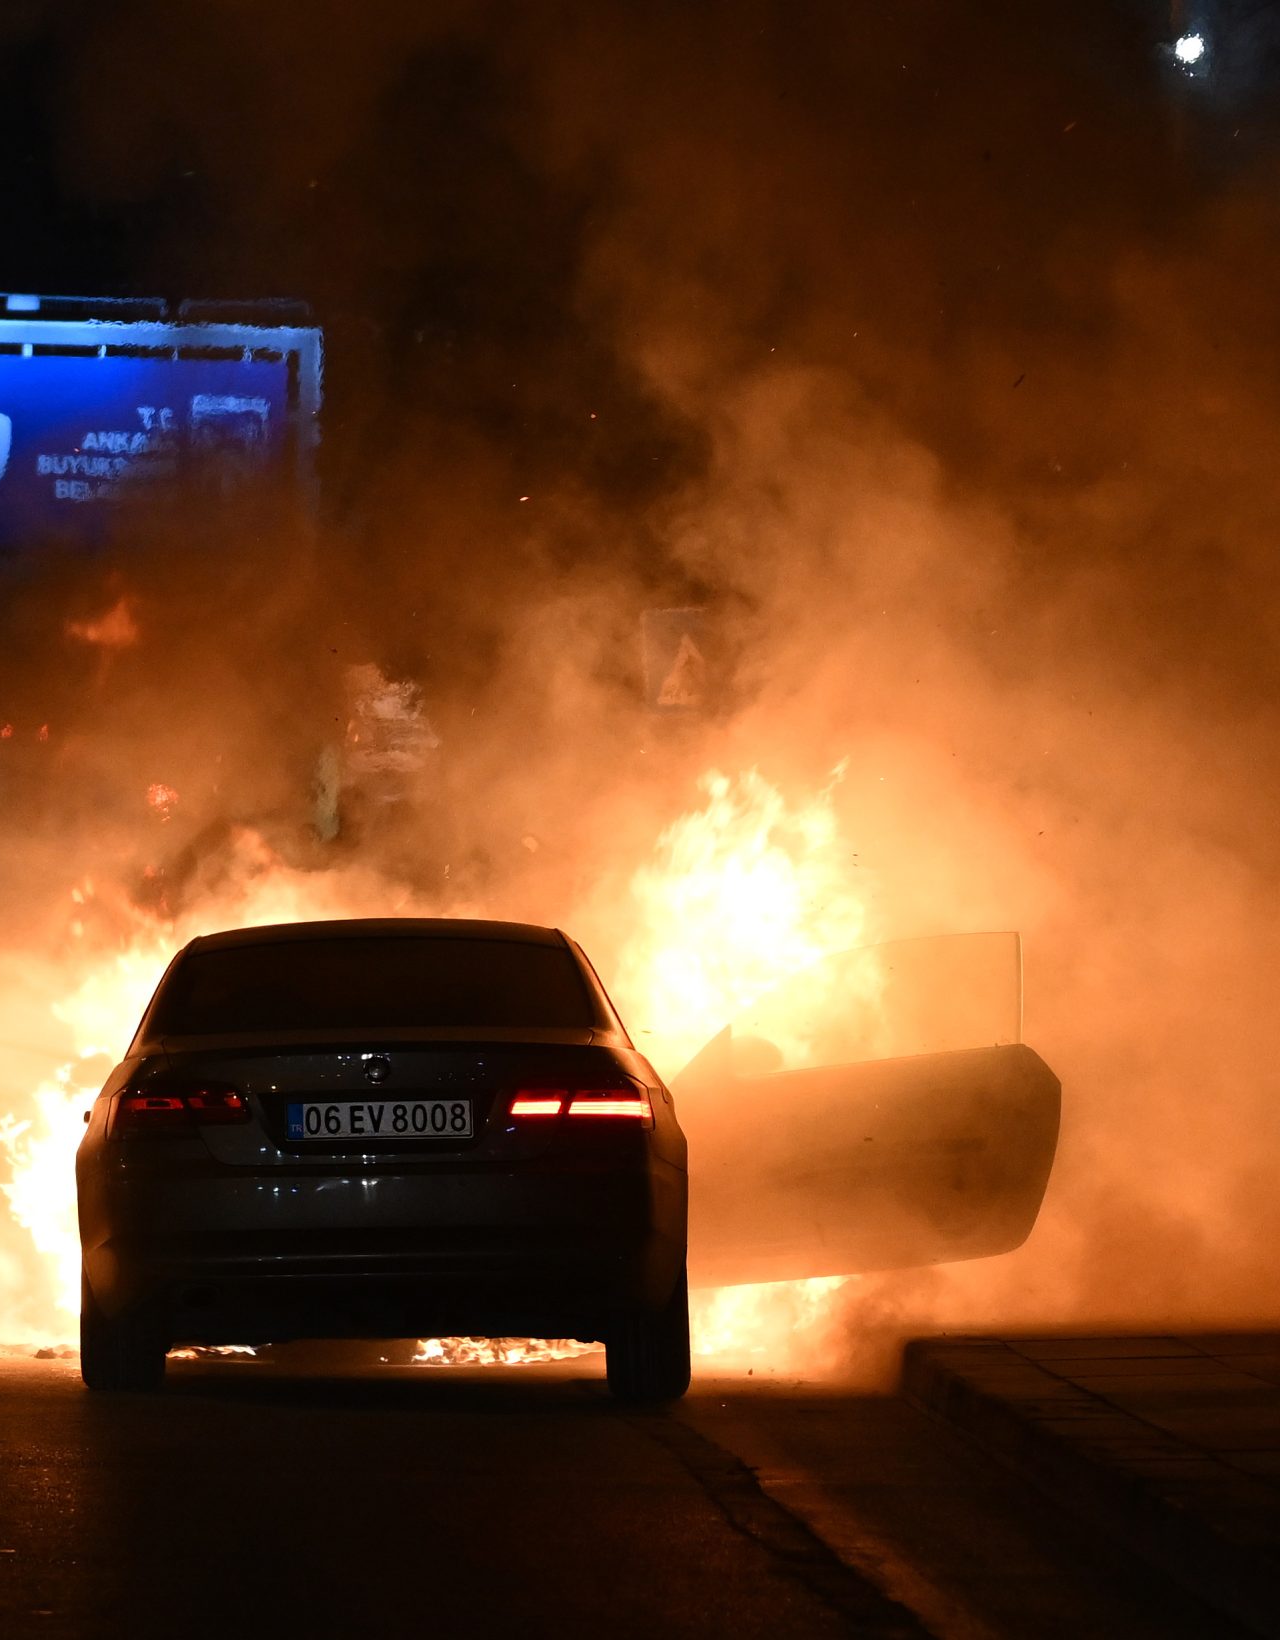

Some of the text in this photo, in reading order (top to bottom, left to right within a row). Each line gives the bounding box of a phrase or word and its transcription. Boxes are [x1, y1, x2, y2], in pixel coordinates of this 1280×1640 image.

[305, 1103, 467, 1135] 06 EV 8008
